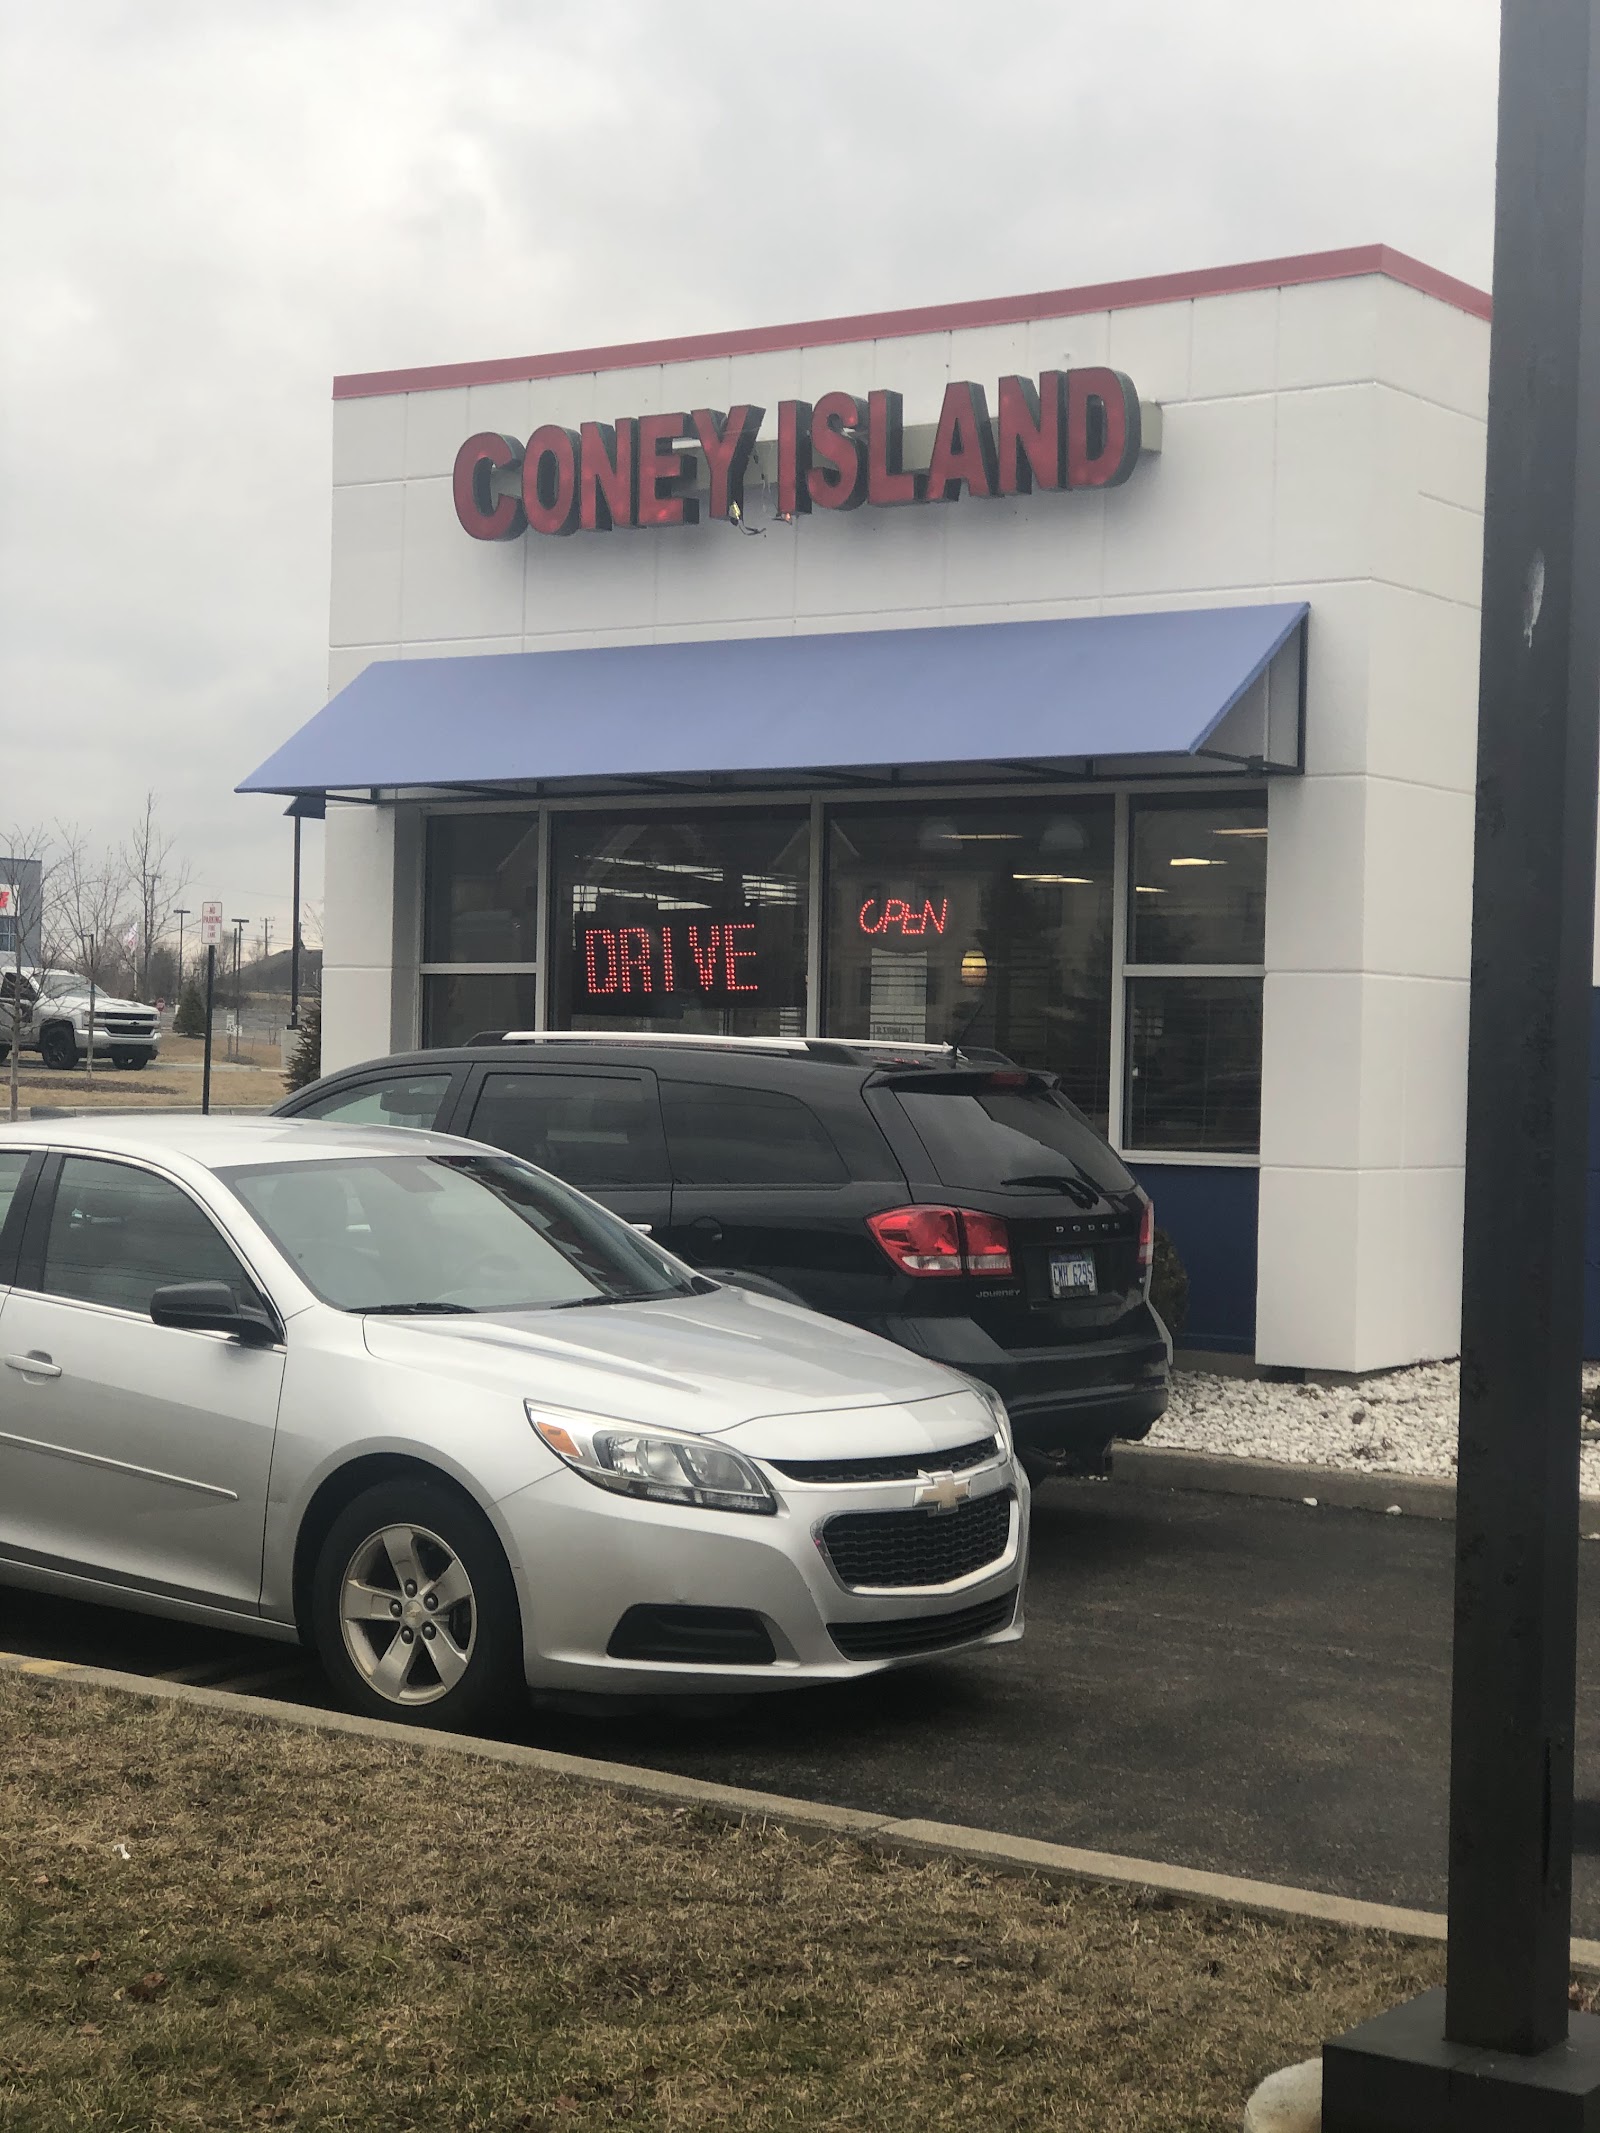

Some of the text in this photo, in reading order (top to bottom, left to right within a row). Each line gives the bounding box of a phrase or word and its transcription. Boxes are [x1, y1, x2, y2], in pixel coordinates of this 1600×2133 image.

[453, 366, 1142, 541] CONEY ISLAND
[859, 898, 948, 935] OPEN
[585, 923, 759, 994] DRIVE
[975, 1289, 1021, 1298] JOURNEY
